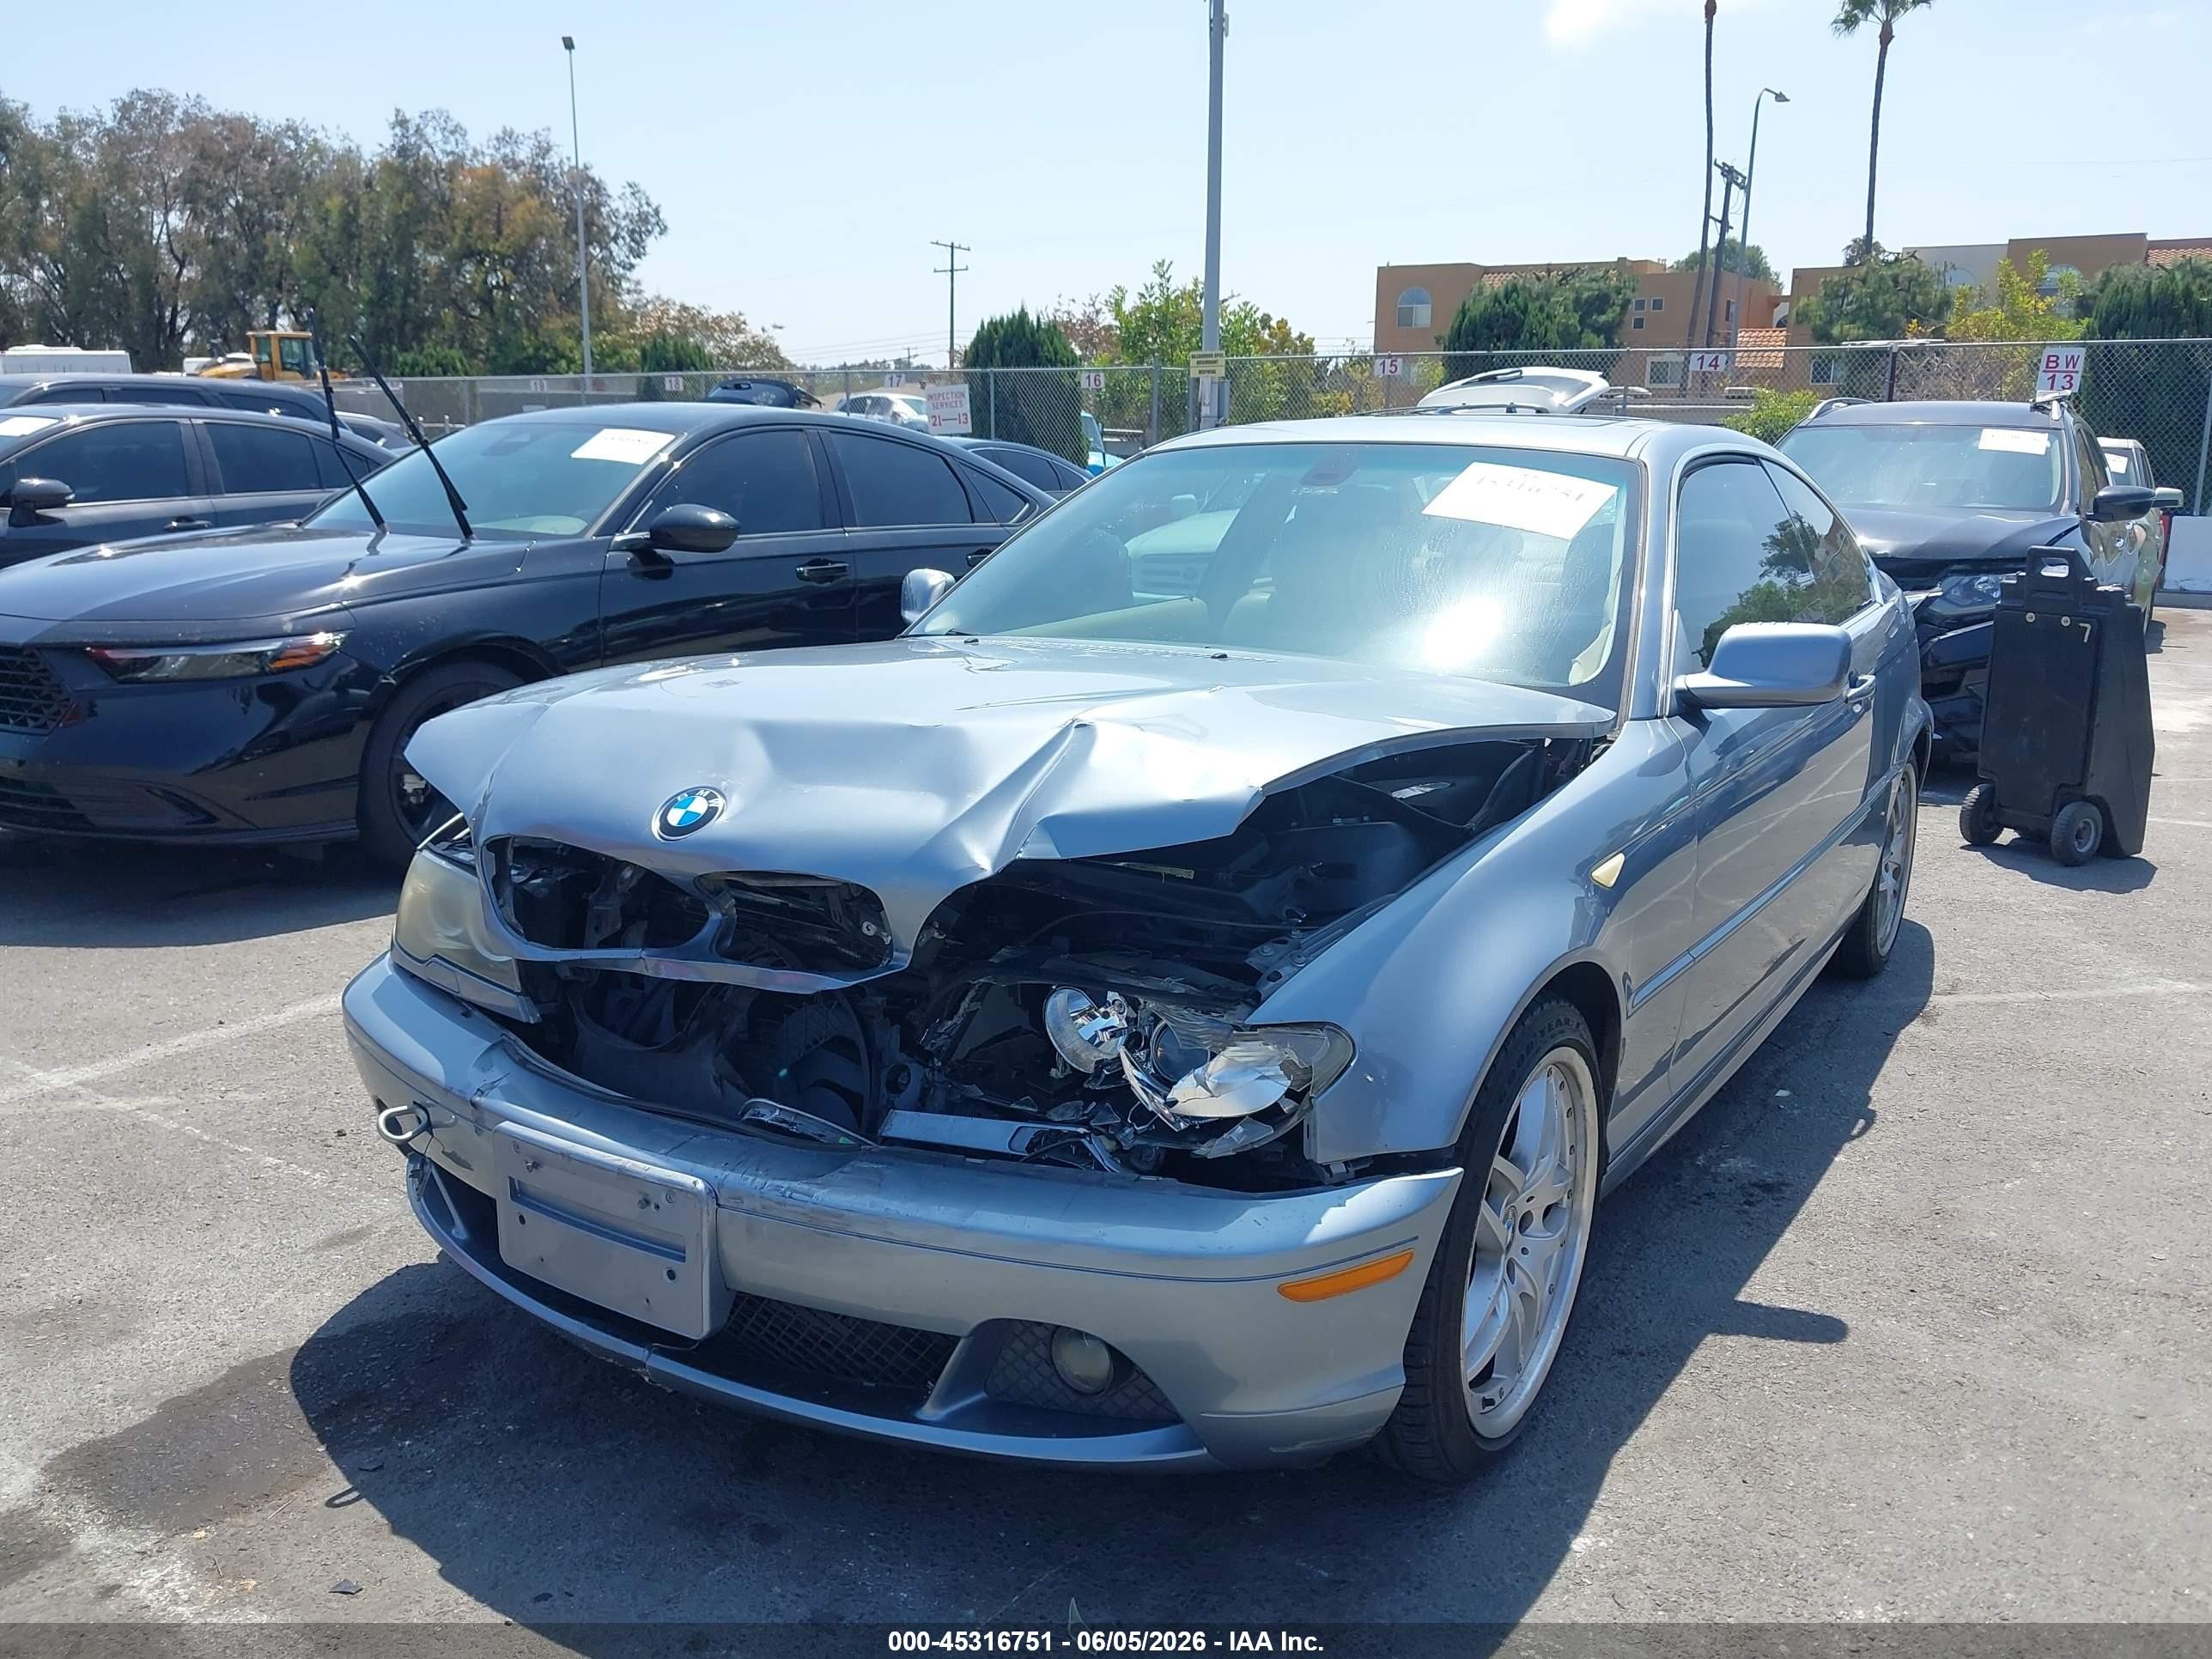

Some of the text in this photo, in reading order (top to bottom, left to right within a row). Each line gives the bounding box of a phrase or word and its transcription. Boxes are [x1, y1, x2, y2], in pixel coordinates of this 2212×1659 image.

[1379, 359, 1398, 374] 15
[1696, 354, 1720, 370] 14
[2045, 354, 2081, 369] BW
[889, 375, 902, 387] 17
[1085, 374, 1101, 387] 16
[2046, 374, 2075, 390] 13
[2078, 623, 2092, 643] 7
